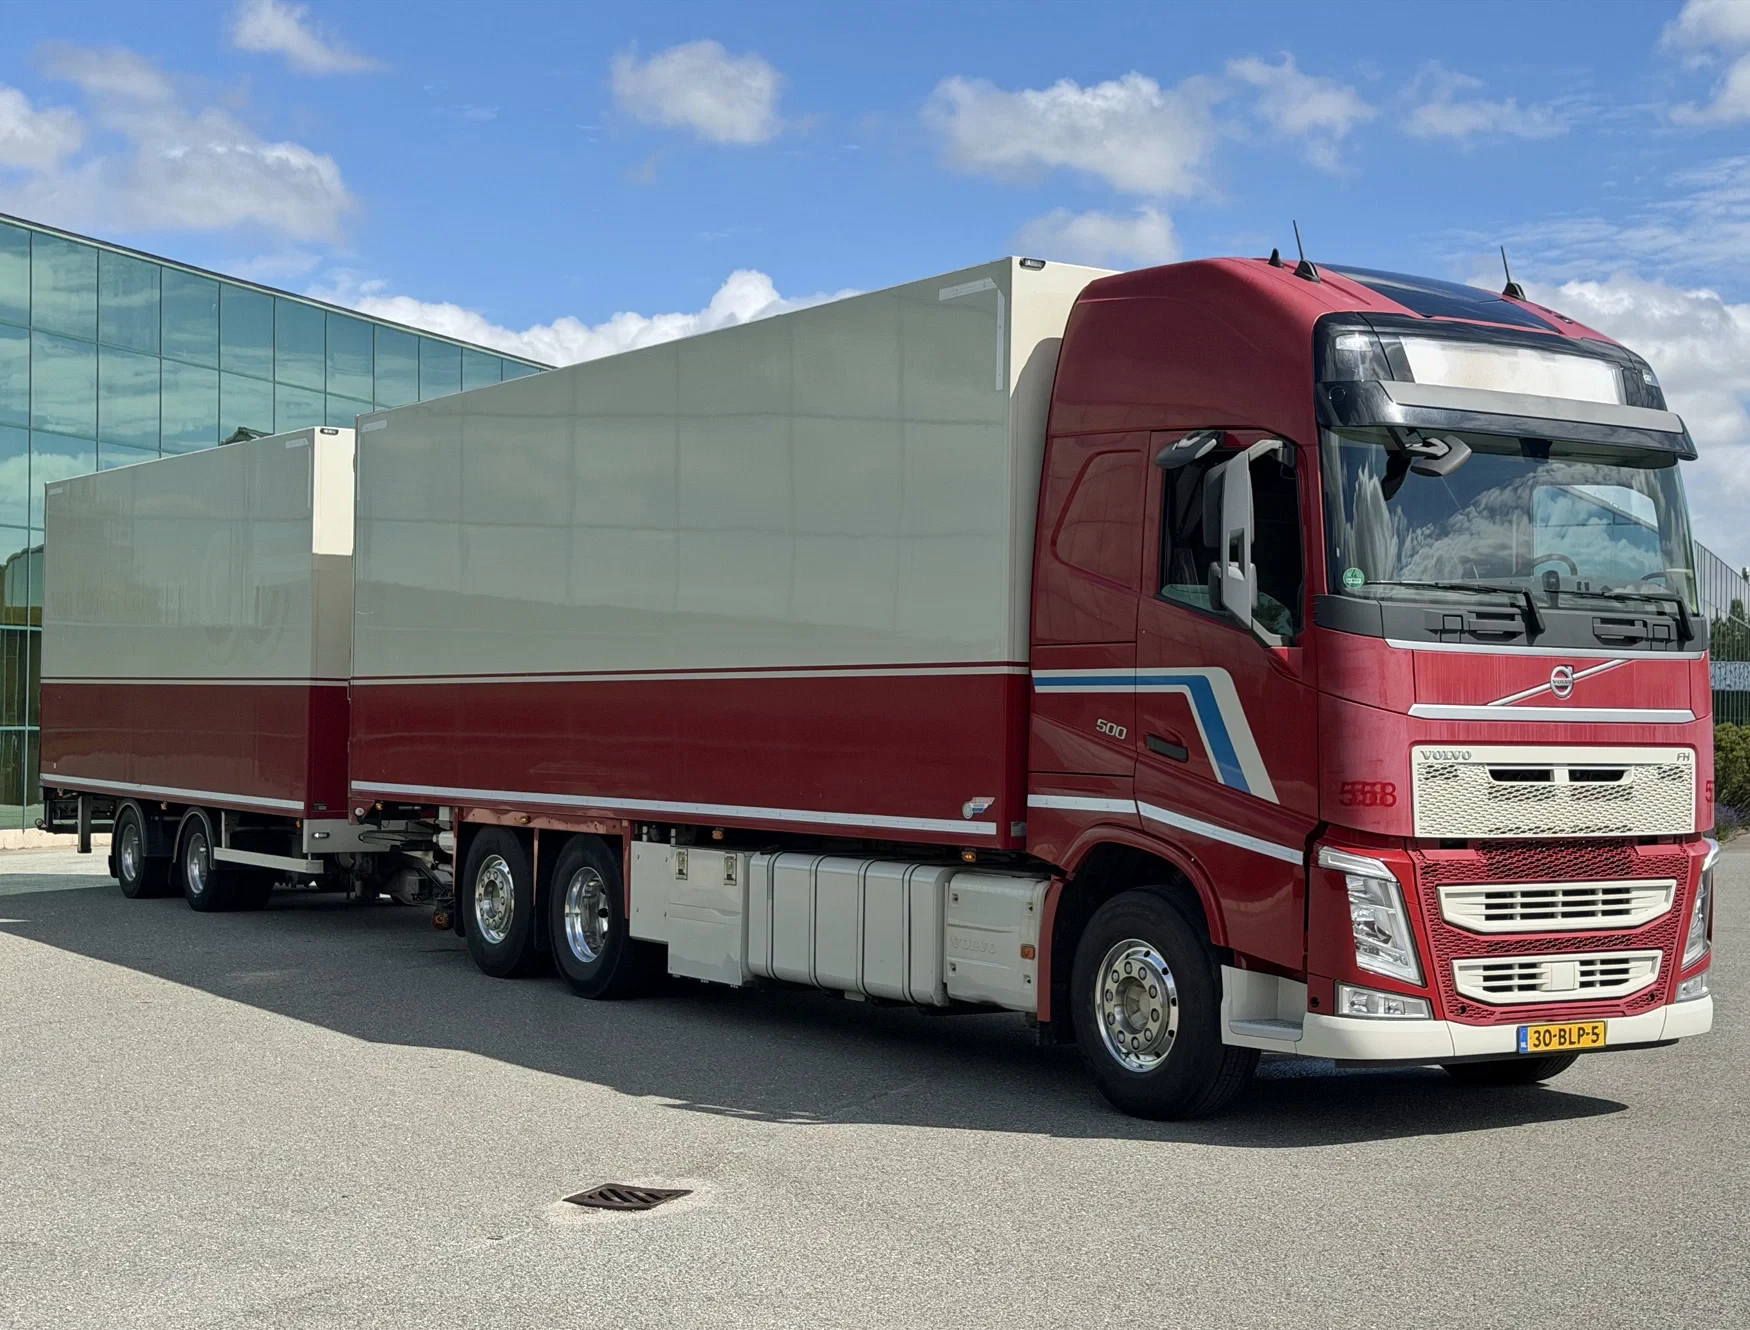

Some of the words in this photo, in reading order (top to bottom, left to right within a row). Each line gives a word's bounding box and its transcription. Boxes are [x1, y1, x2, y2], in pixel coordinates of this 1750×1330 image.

[1096, 718, 1127, 740] 500
[1420, 750, 1472, 761] VOLVO
[1676, 752, 1690, 762] FH
[950, 936, 998, 955] VOLVO
[1533, 1026, 1599, 1048] 30-BLP-5
